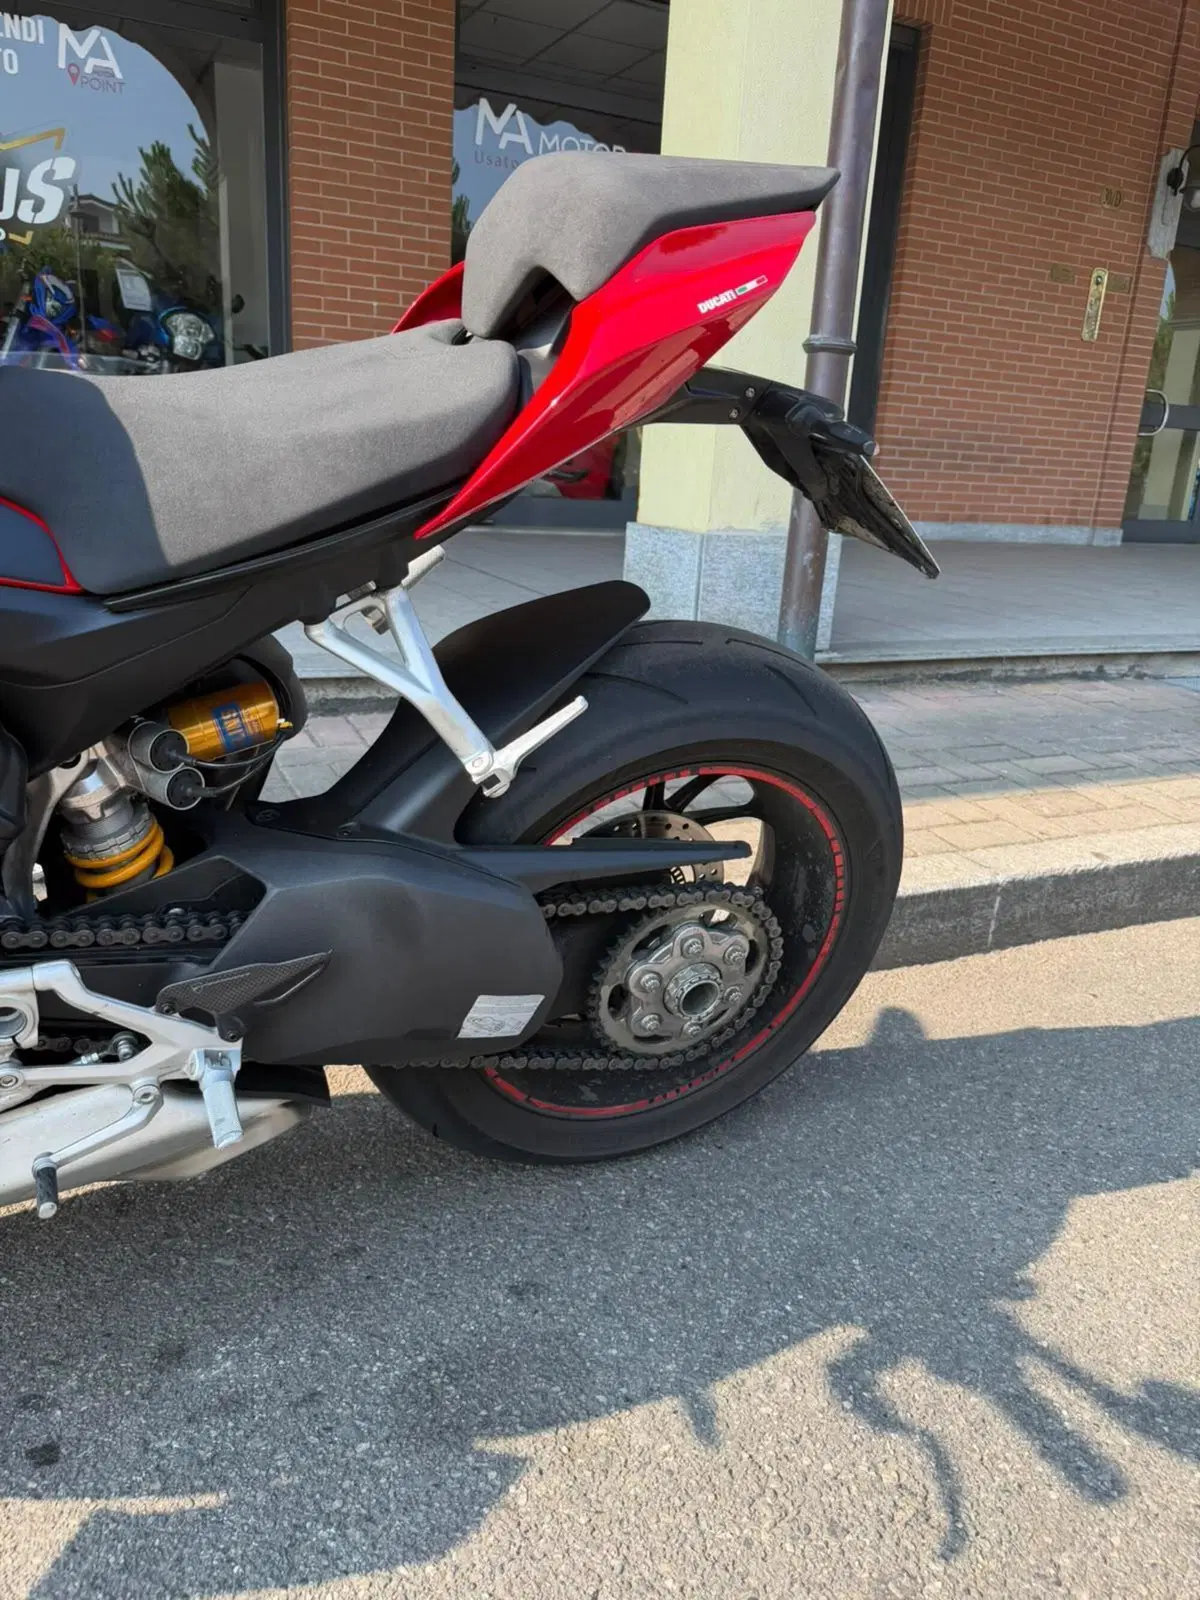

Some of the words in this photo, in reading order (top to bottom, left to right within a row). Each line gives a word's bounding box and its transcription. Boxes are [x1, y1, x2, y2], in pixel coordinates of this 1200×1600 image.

[0, 11, 45, 45] NDI
[58, 23, 123, 79] MA
[80, 75, 127, 93] POINT
[475, 97, 533, 154] MA
[697, 289, 737, 315] DUCATI
